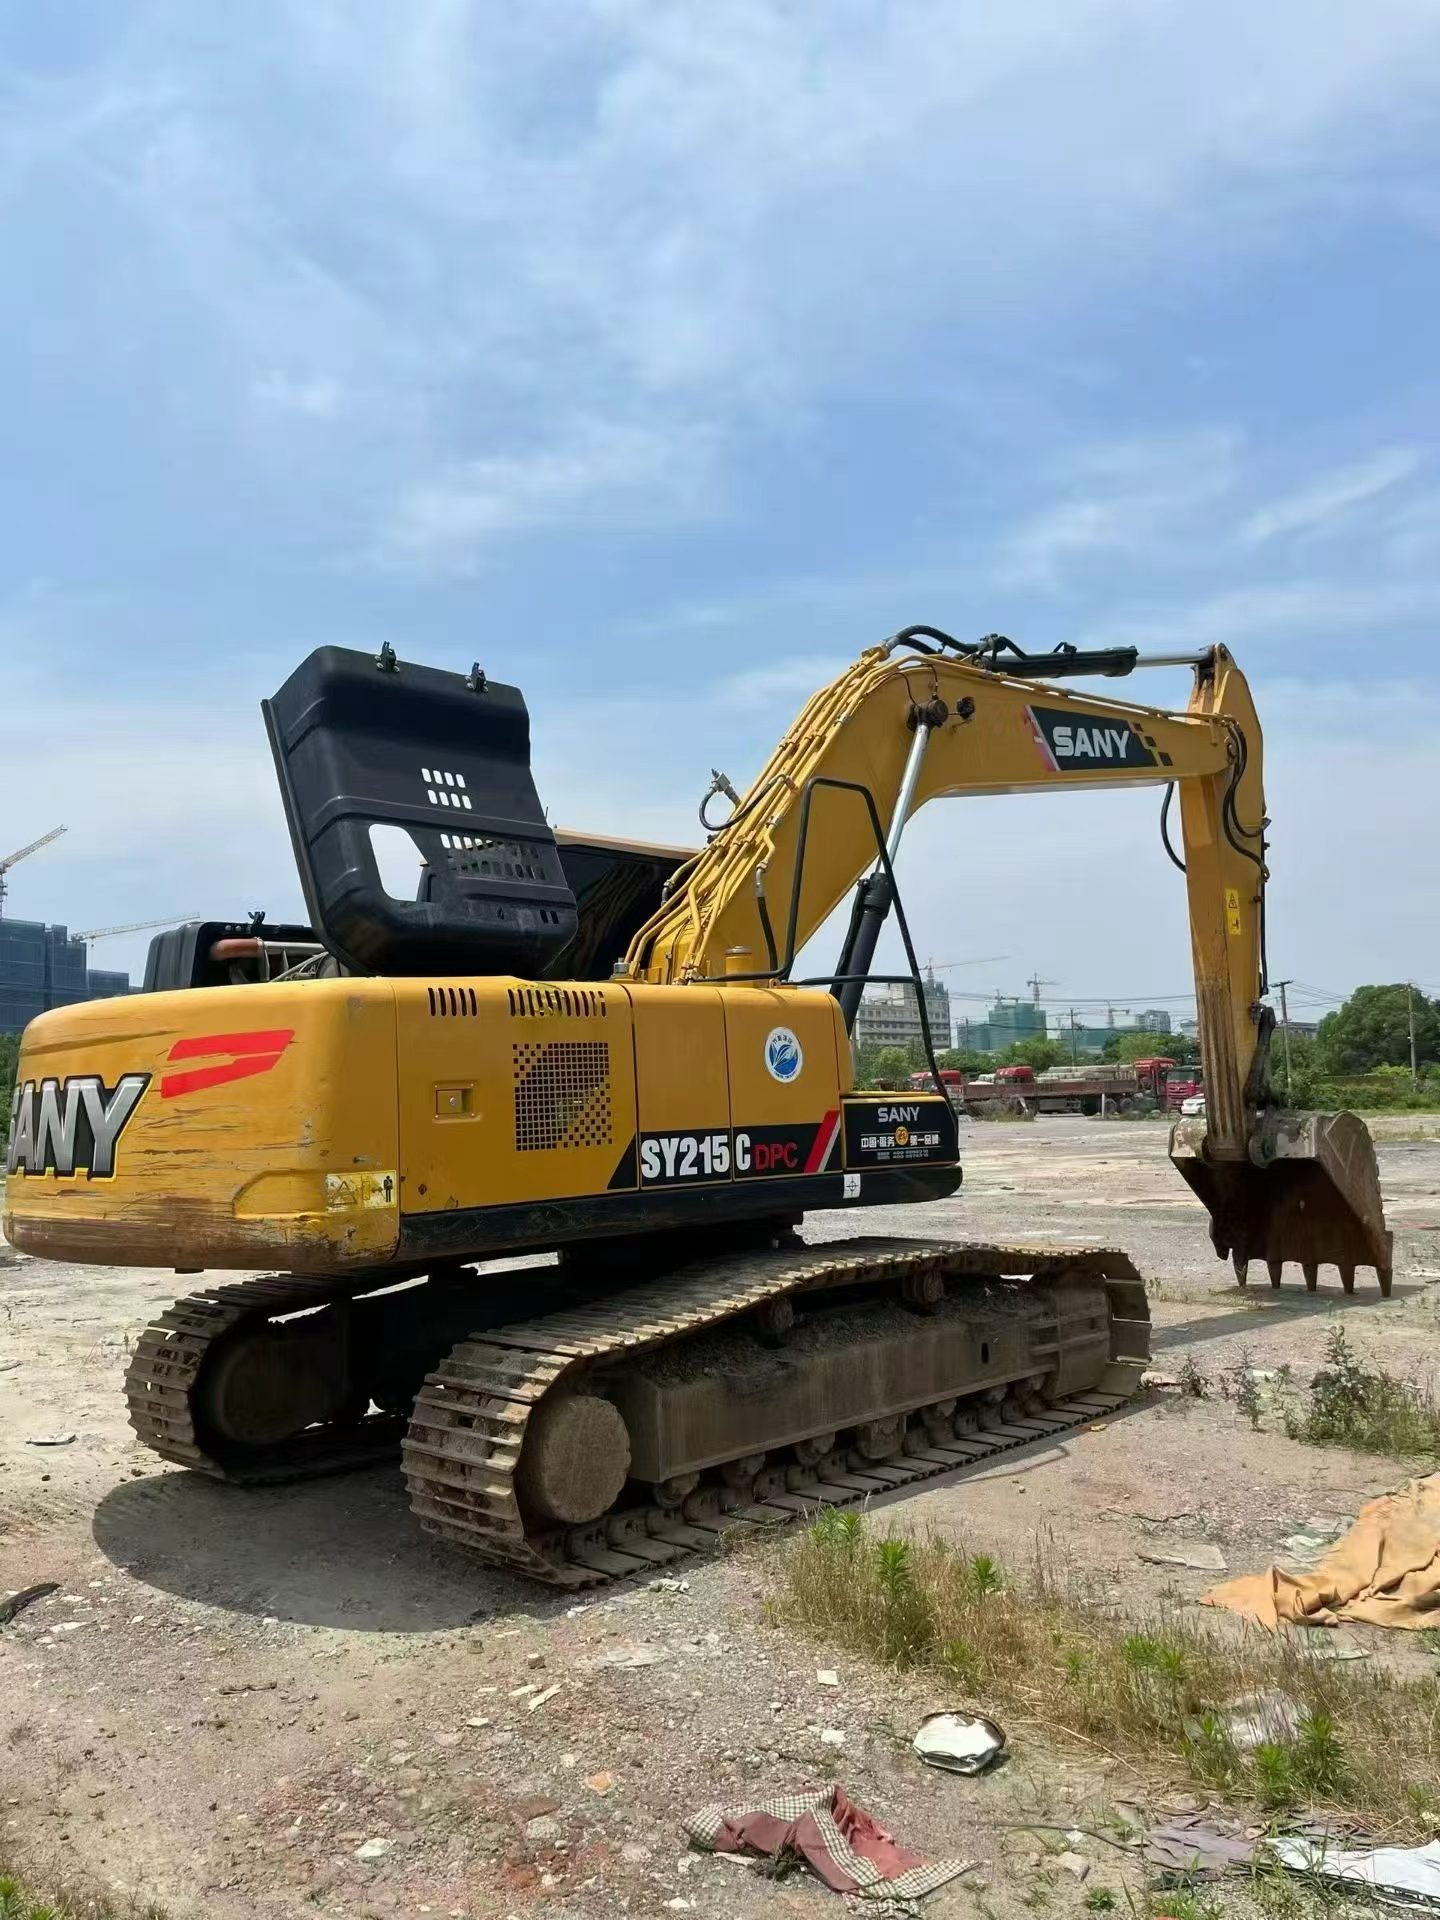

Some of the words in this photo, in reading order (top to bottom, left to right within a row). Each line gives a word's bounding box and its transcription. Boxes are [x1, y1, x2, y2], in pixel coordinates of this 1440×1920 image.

[1053, 727, 1130, 759] SANY
[7, 1075, 148, 1175] ANY
[877, 1106, 920, 1123] SANY
[755, 1143, 799, 1170] DPC
